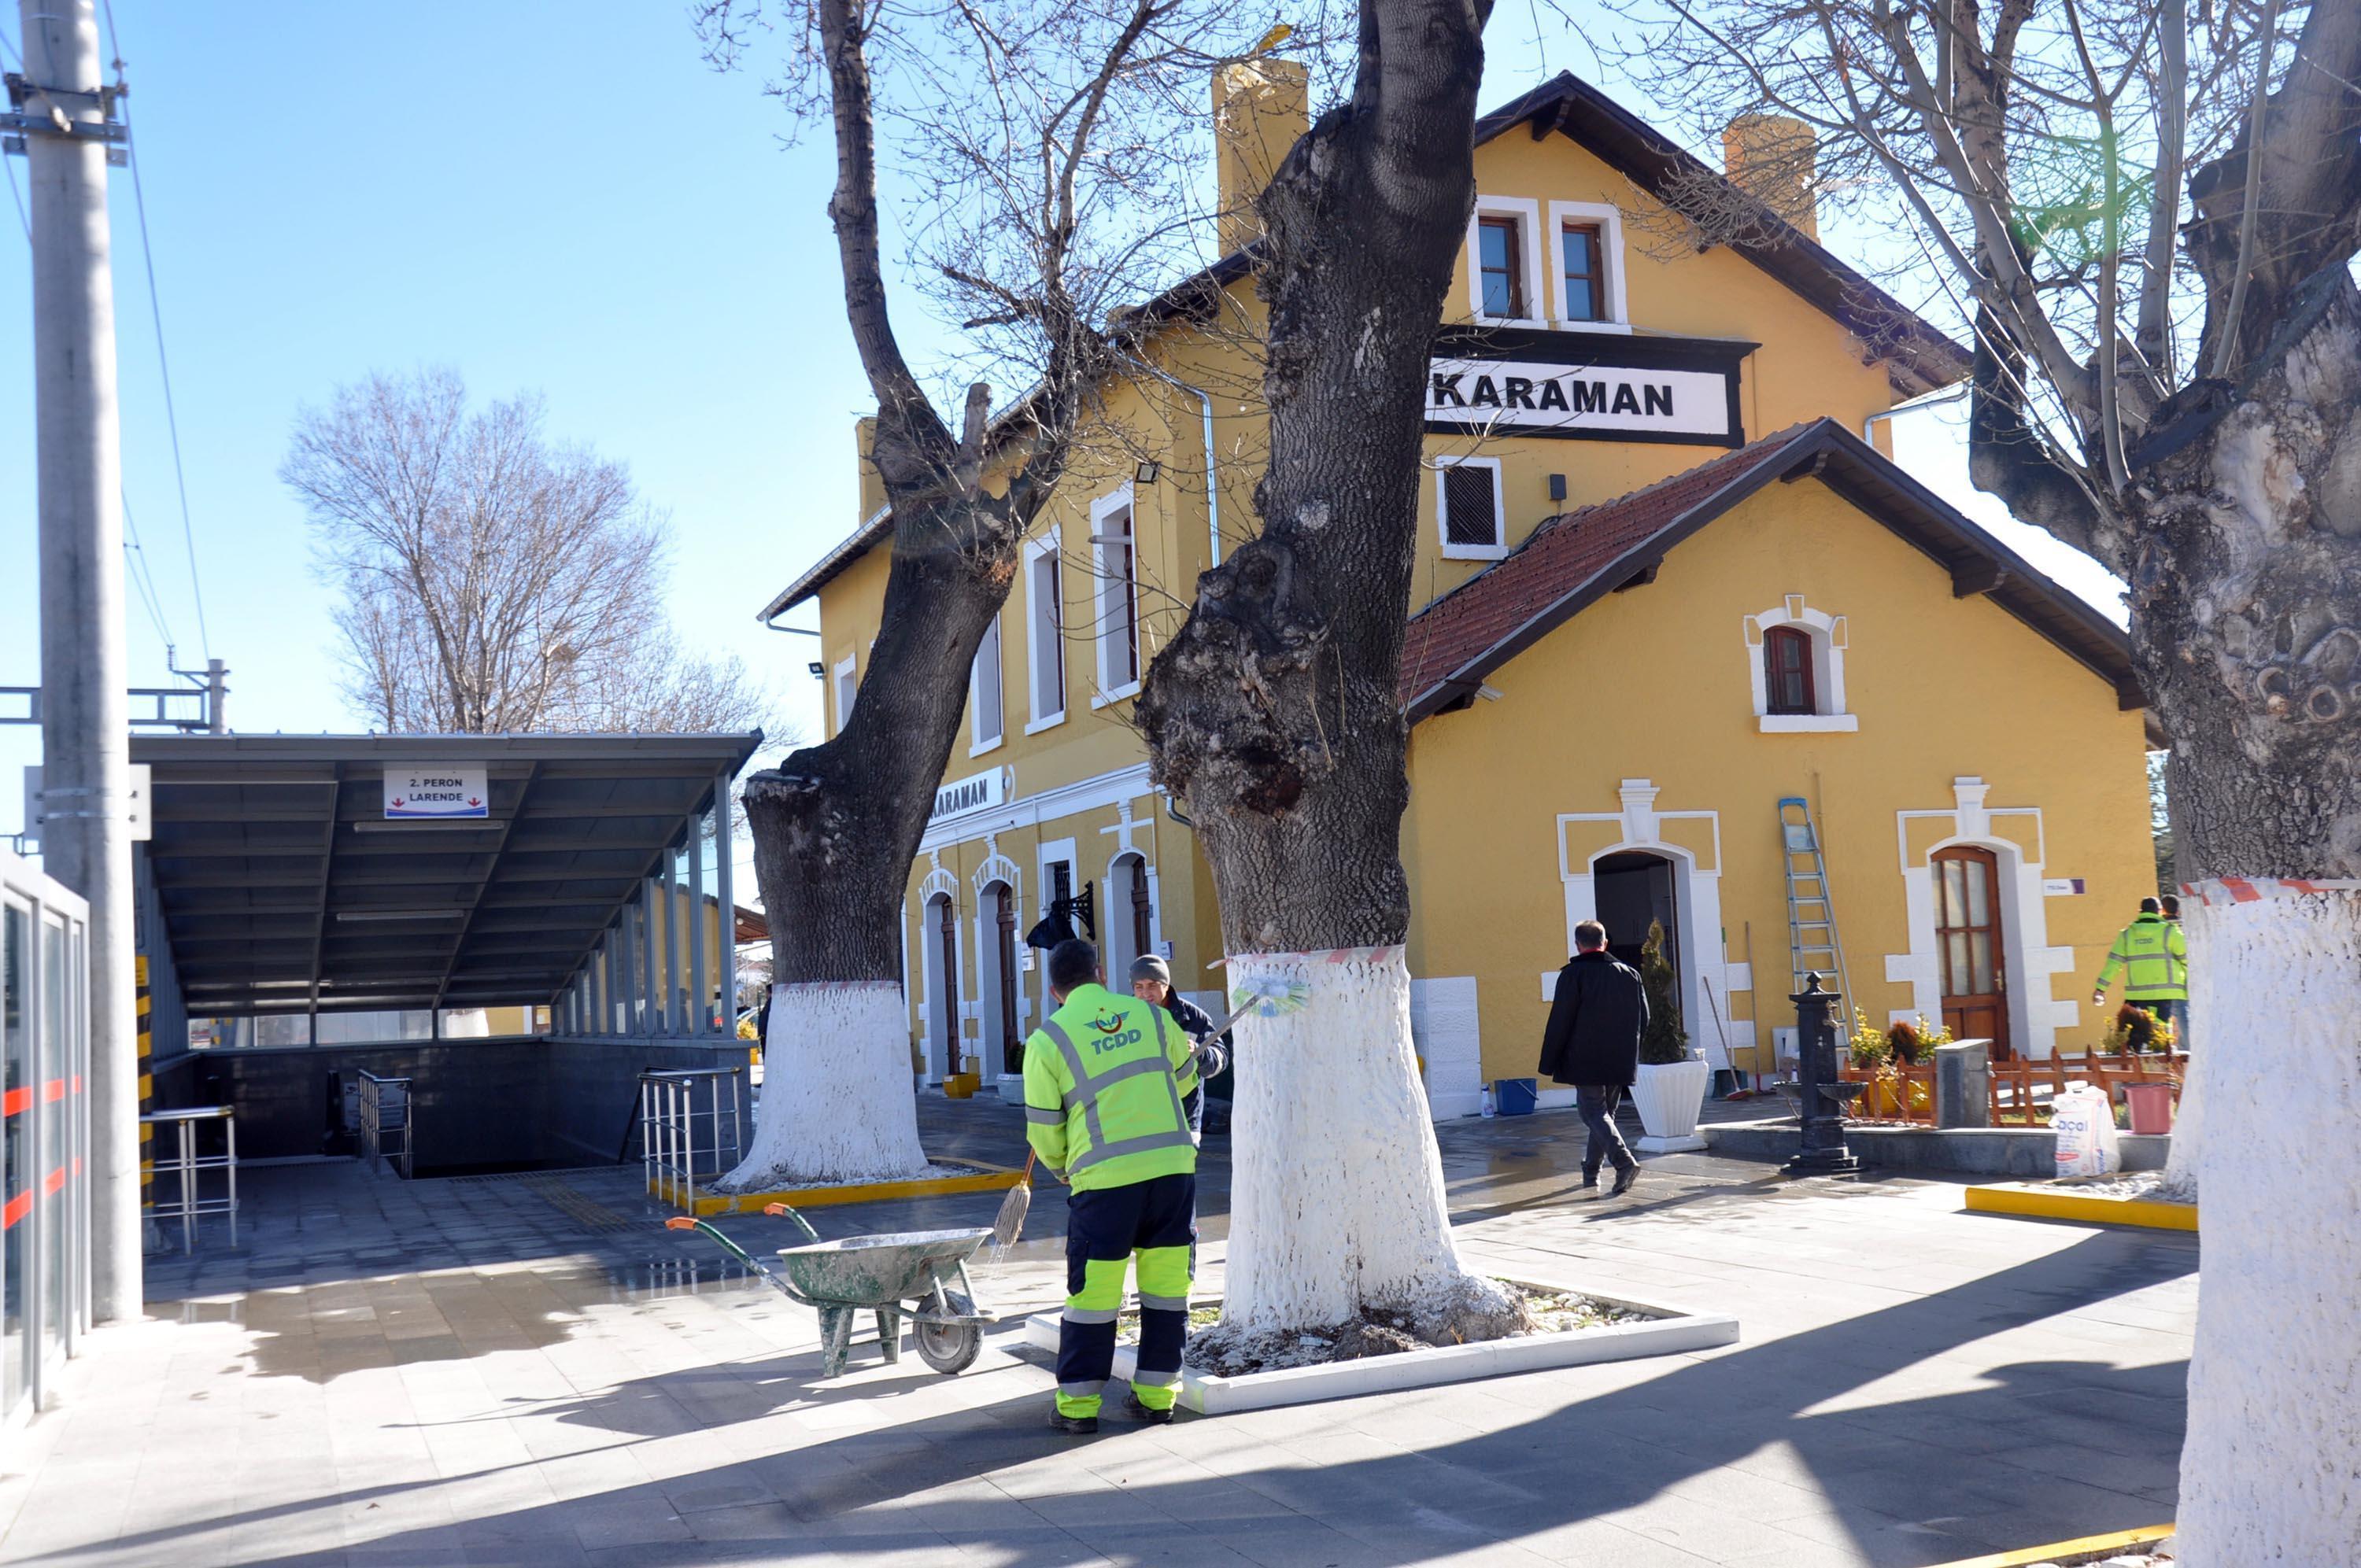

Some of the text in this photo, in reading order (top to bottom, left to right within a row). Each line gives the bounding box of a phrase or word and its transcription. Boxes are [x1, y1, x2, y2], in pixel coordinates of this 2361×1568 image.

[1433, 373, 1674, 416] KARAMAN
[409, 779, 463, 788] 2. PERON
[409, 792, 464, 802] LARENDE
[1091, 1029, 1142, 1055] TCDD
